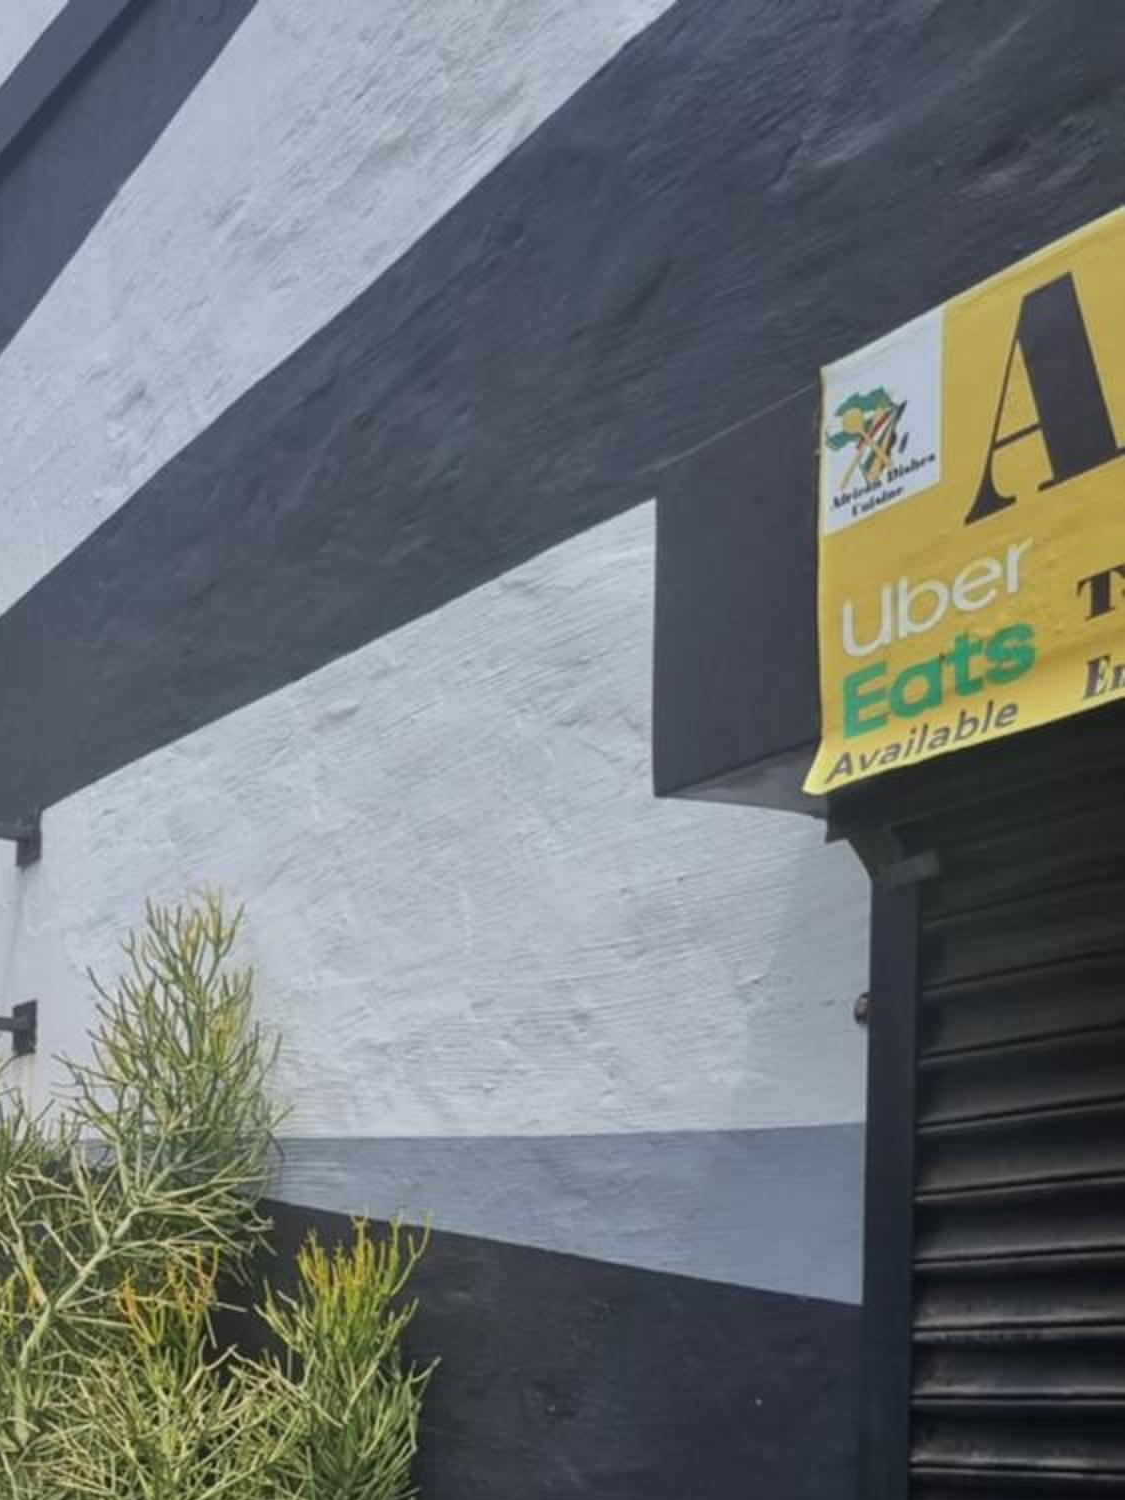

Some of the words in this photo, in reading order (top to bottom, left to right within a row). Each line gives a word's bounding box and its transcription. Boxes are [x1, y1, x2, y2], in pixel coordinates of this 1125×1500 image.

[841, 536, 1034, 657] Uber
[841, 622, 1037, 740] Eats
[825, 699, 1020, 784] Available
